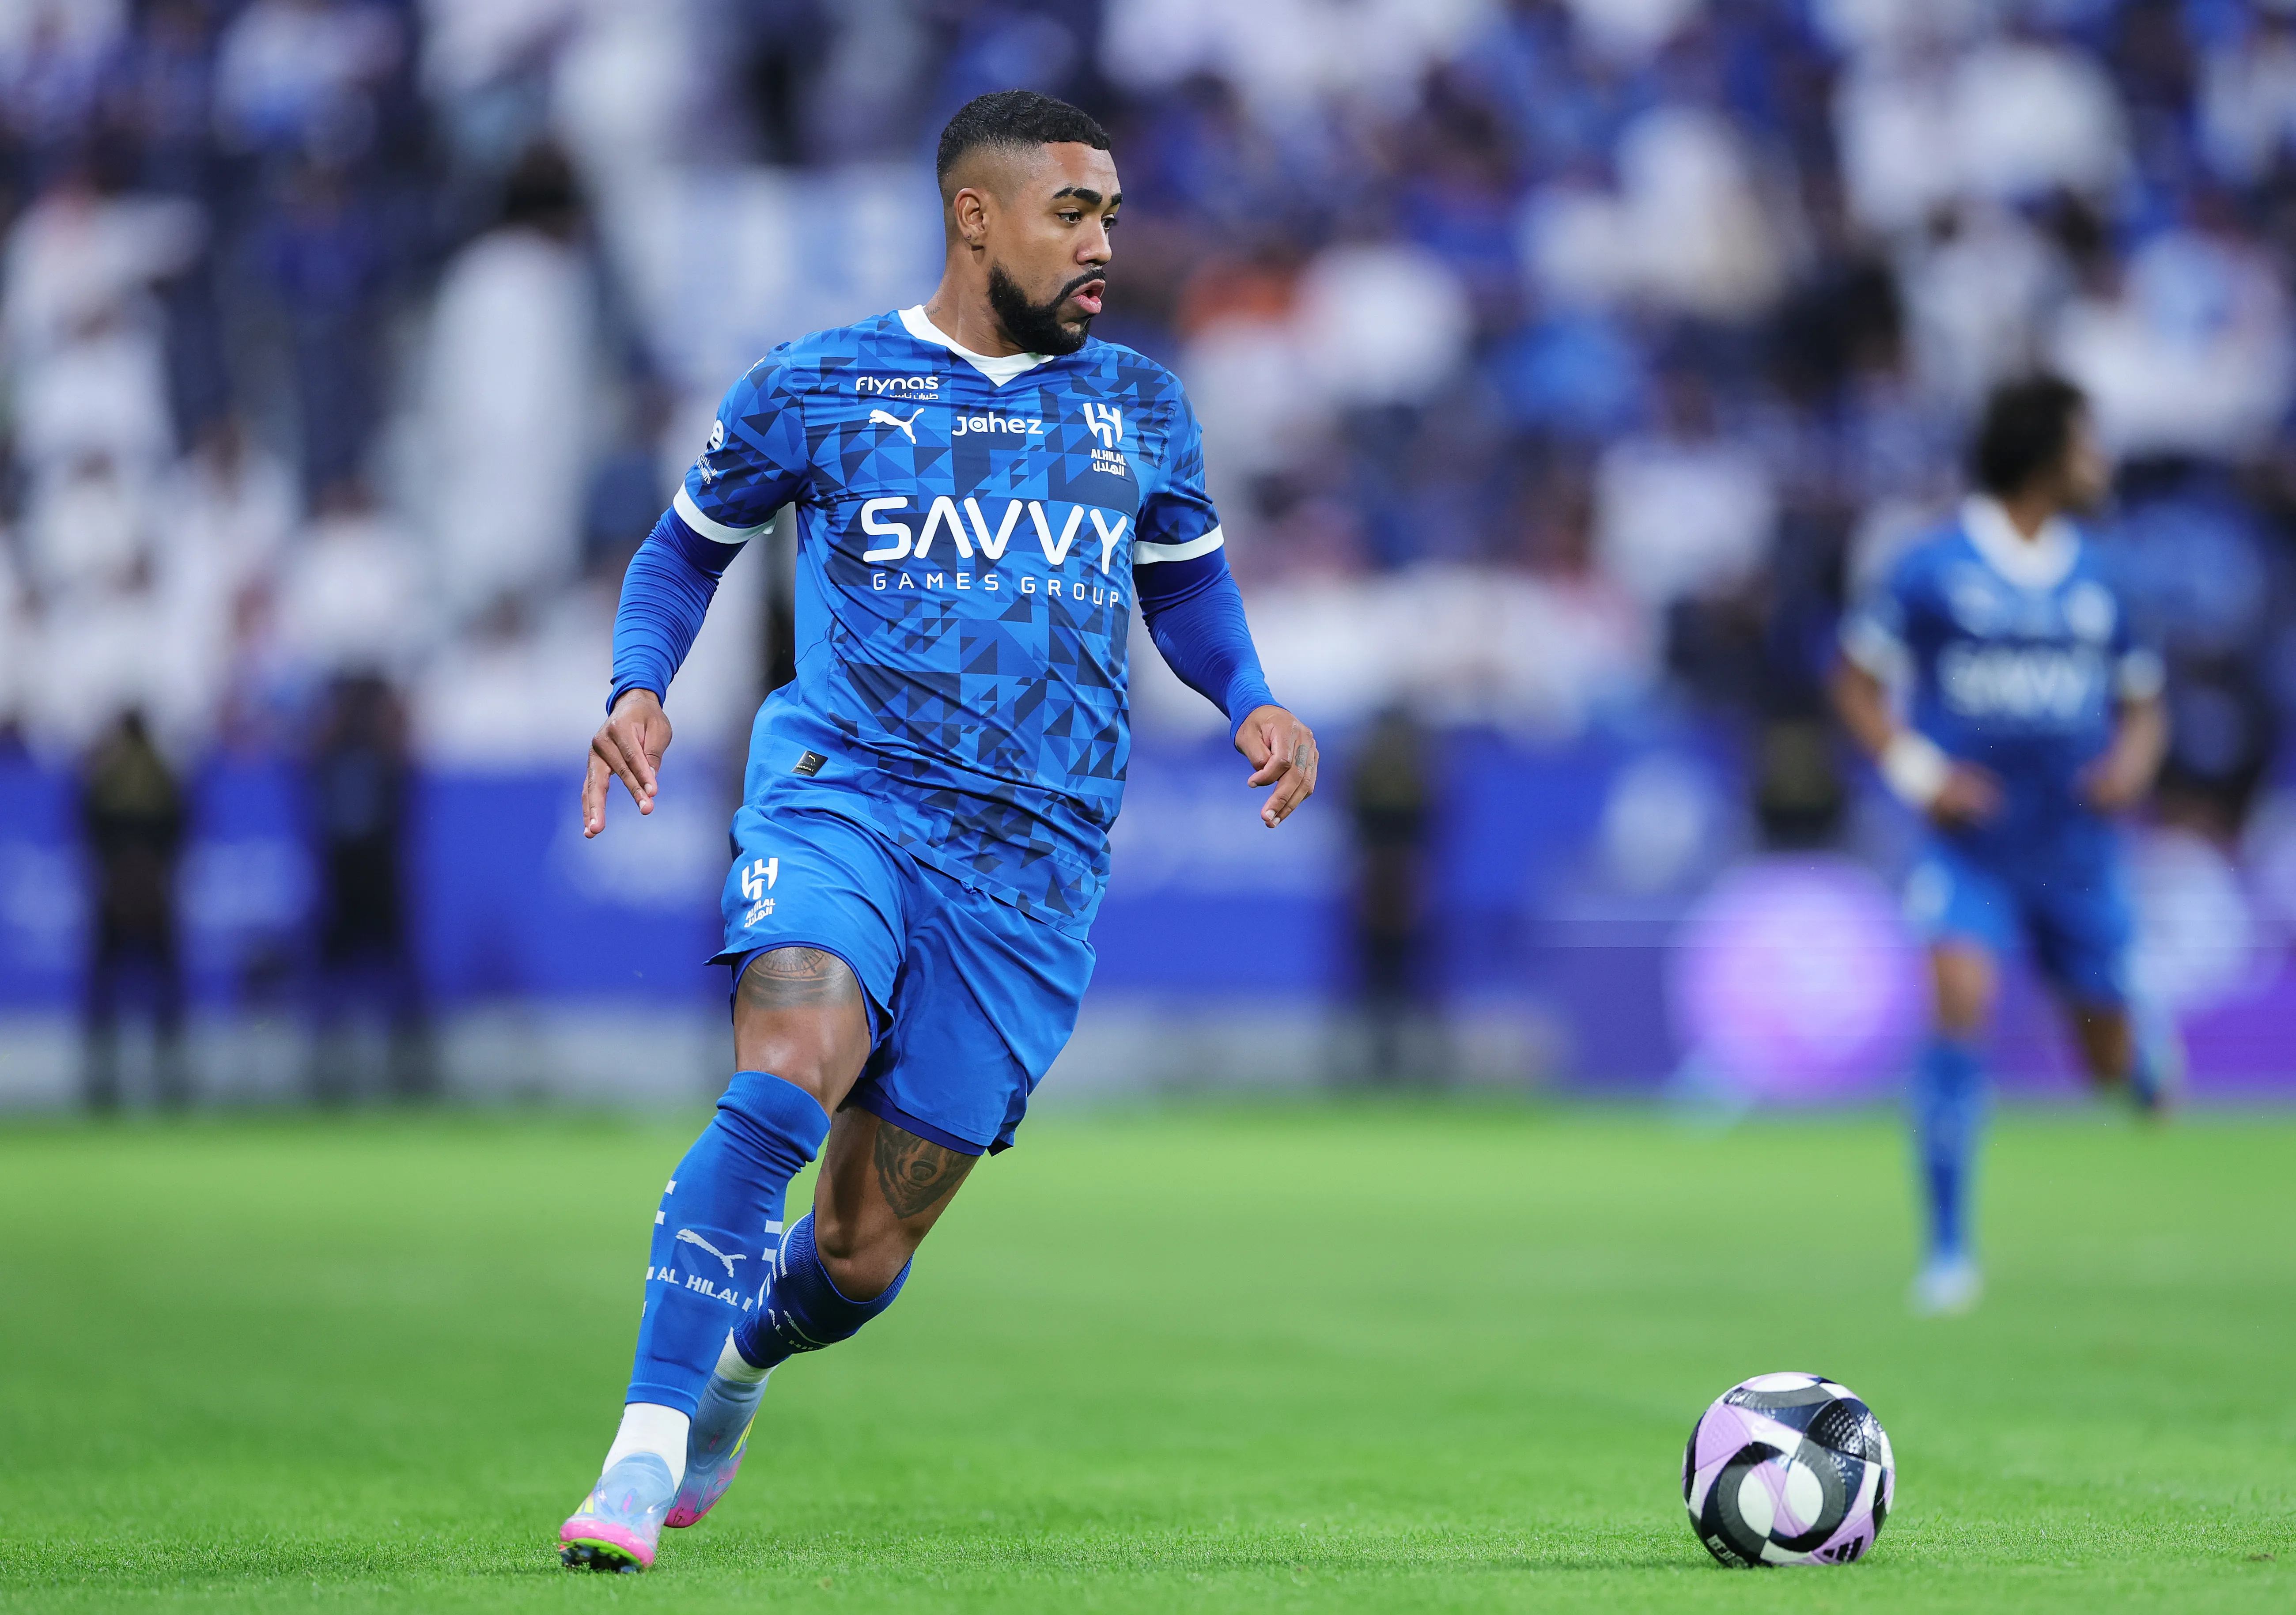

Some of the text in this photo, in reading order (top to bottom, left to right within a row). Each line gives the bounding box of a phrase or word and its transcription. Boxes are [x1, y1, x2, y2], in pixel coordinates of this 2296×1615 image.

[855, 376, 938, 395] flynas
[861, 496, 1127, 575] SAVVY
[873, 572, 1119, 608] GAMES GROUP
[657, 1266, 738, 1306] AL HILAL
